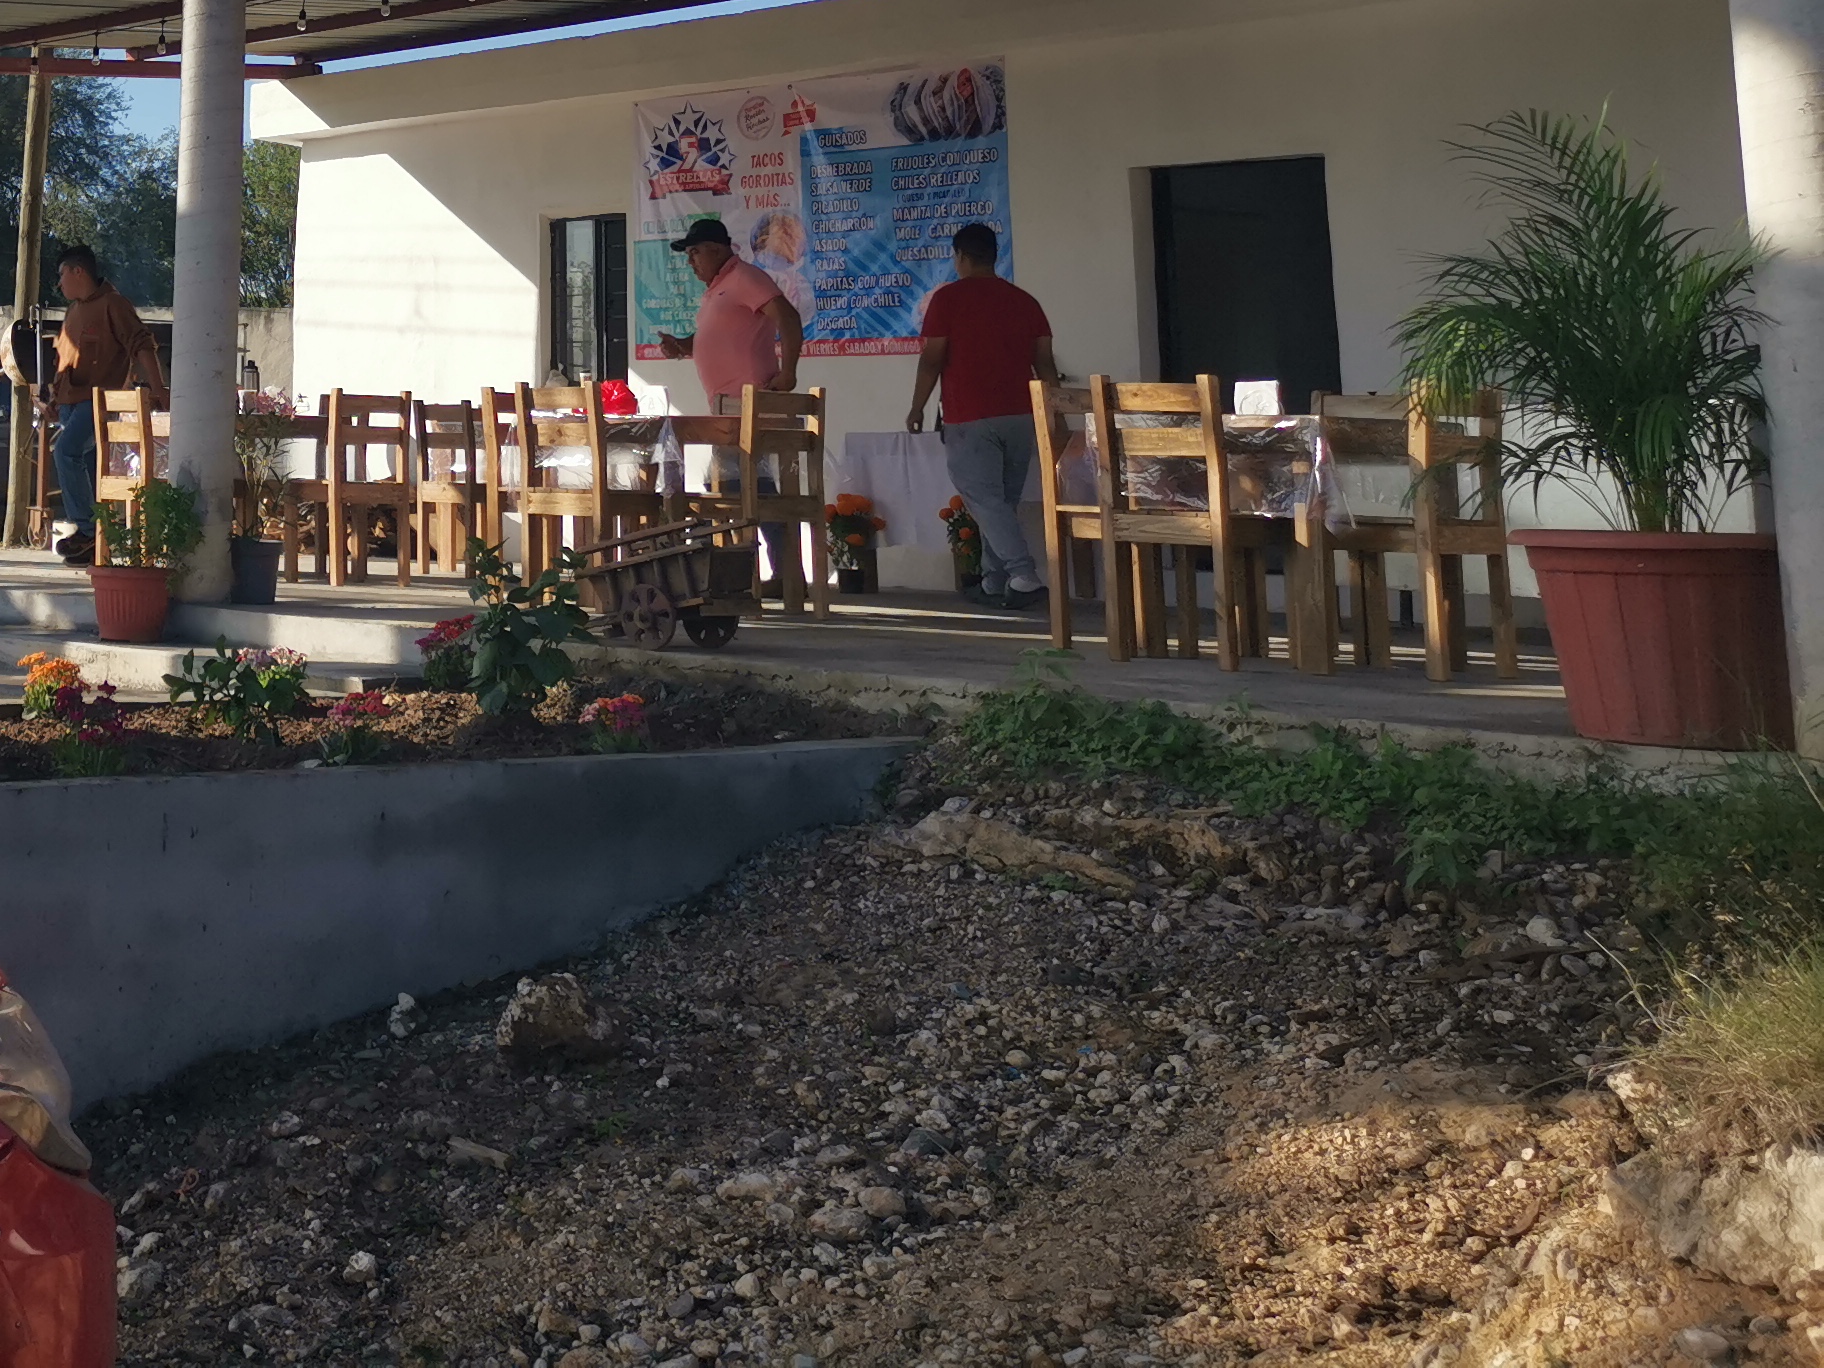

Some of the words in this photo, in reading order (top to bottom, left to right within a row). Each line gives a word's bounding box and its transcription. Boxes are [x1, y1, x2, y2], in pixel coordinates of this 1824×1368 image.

[818, 130, 867, 148] GUISADOS
[750, 151, 784, 169] TACOS
[891, 153, 936, 172] FRIJOLES
[937, 151, 961, 167] CON
[962, 147, 999, 166] QUESO
[659, 169, 720, 185] ESTRELLAS
[810, 160, 872, 179] DESHEBRADA
[740, 171, 794, 190] GORDITAS
[810, 181, 838, 197] SALSA
[840, 178, 872, 194] VERDE
[891, 173, 927, 191] CHILES
[929, 169, 981, 188] RELLENOS
[743, 195, 752, 210] Y
[812, 198, 859, 215] PICADILLO
[893, 204, 932, 222] MANITA
[933, 202, 948, 219] DE
[950, 199, 994, 218] PUERCO
[812, 213, 875, 234] CHICHARRÓN
[895, 224, 921, 242] MOLE
[814, 238, 847, 253] ASADO
[815, 257, 846, 272] RAJAS
[815, 276, 855, 292] PAPITAS
[857, 275, 877, 290] CON
[878, 273, 912, 288] HUEVO
[816, 296, 848, 311] HUEVO
[850, 294, 869, 309] CON
[870, 292, 902, 308] CHILE
[809, 343, 838, 355] VIERNES
